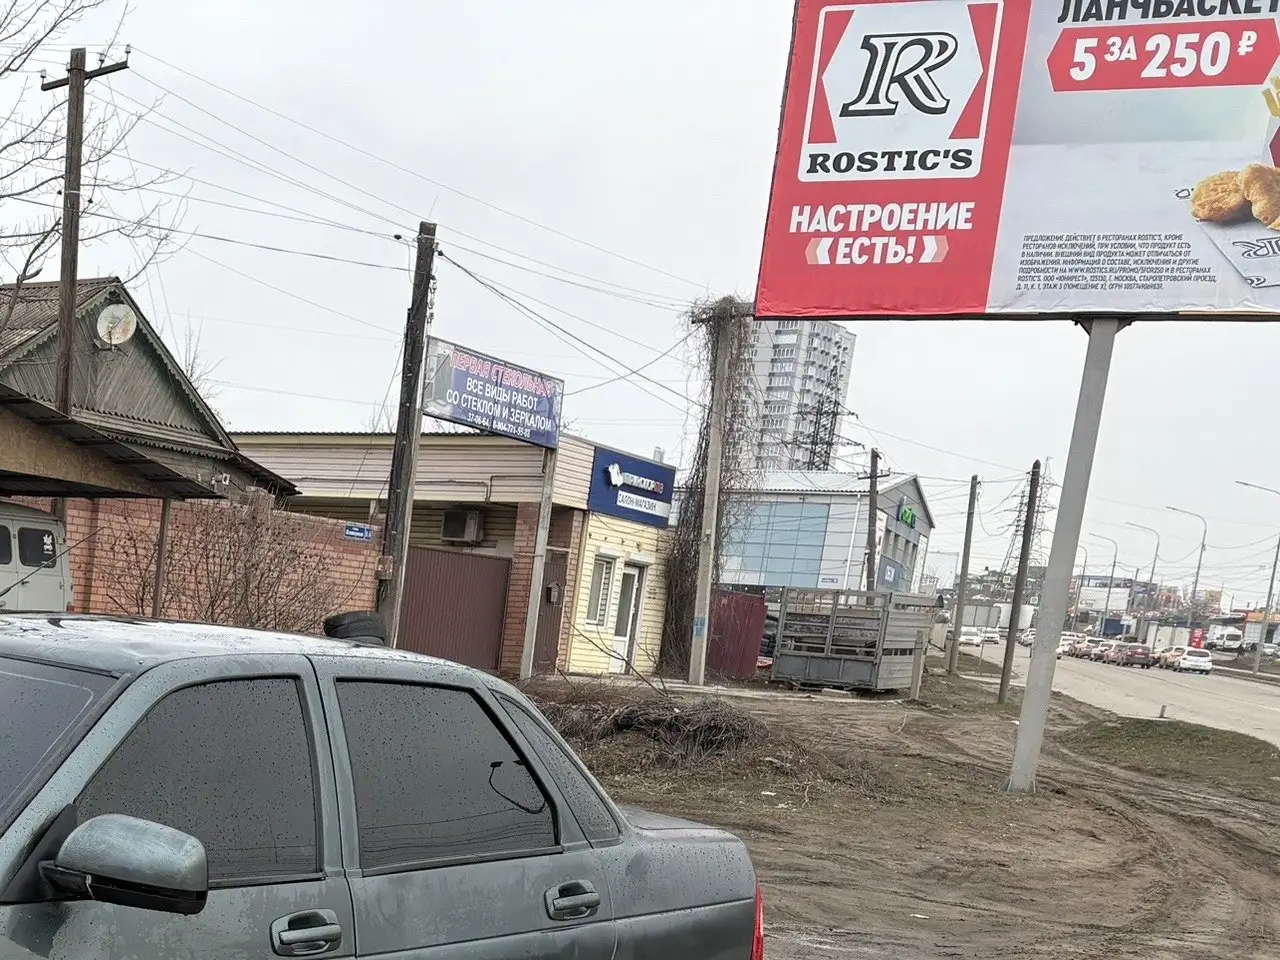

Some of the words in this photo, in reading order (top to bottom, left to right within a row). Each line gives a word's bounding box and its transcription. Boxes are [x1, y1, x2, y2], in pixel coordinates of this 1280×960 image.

[1069, 37, 1099, 81] 5
[1103, 35, 1138, 62] ЗА
[1140, 31, 1231, 78] 250
[839, 31, 959, 118] R
[806, 148, 973, 174] ROSTIC'S
[789, 201, 975, 233] НАСТРОЕНИЕ
[835, 236, 917, 265] ЕСТЬ!
[1023, 234, 1064, 242] ПРЕДЛОЖЕНИЕ
[1065, 232, 1096, 242] ДЕЙСТВУЕТ
[1164, 233, 1183, 241] КРОМЕ
[1150, 242, 1176, 250] ПРОДУКТ
[1055, 249, 1082, 258] ВНЕШНИЙ
[1083, 250, 1095, 258] ВИД
[1096, 250, 1125, 258] ПРОДУКТА
[1062, 258, 1101, 266] ИНФОРМАЦИЯ
[1178, 258, 1200, 266] ДРУГИЕ
[1139, 273, 1193, 282] СТАРОПЕТРОВСКИЙ
[1175, 266, 1212, 274] РЕСТОРАНАХ
[450, 350, 491, 379] ПЕРВАЯ
[491, 364, 554, 398] СТЕКОЛЬНАЯ
[466, 377, 484, 395] ВСЕ
[484, 382, 511, 403] ВИДЫ
[511, 390, 538, 411] РАБОТ
[446, 389, 460, 405] СО
[461, 393, 501, 419] СТЕКЛОМ
[502, 406, 509, 420] И
[510, 408, 552, 432] ЗЕРКАЛОМ
